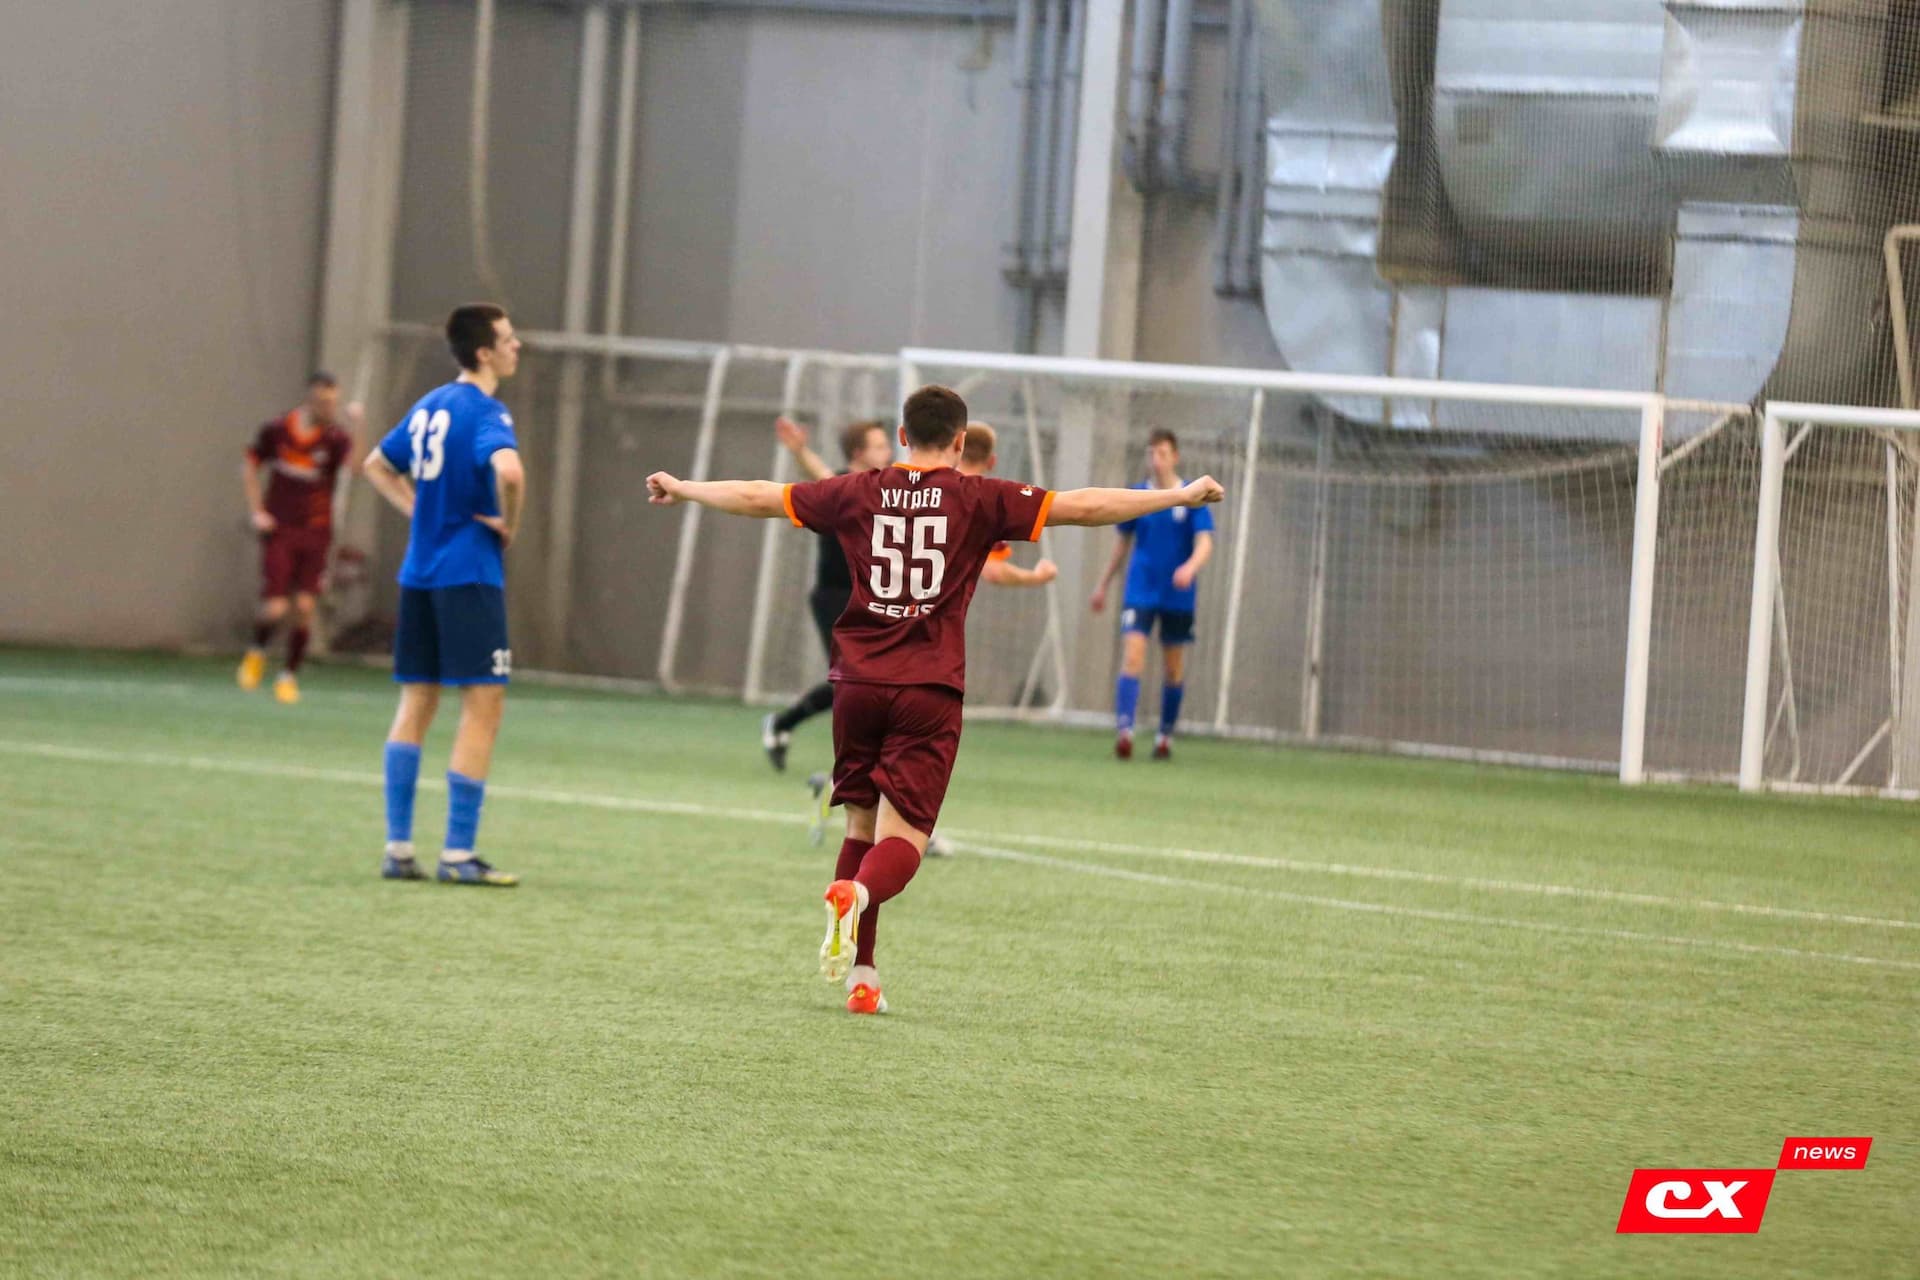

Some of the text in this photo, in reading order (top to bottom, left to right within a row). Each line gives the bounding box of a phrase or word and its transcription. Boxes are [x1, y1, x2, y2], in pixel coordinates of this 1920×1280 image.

[408, 408, 450, 480] 33
[881, 487, 943, 509] ХУГАЕВ
[870, 514, 948, 600] 55
